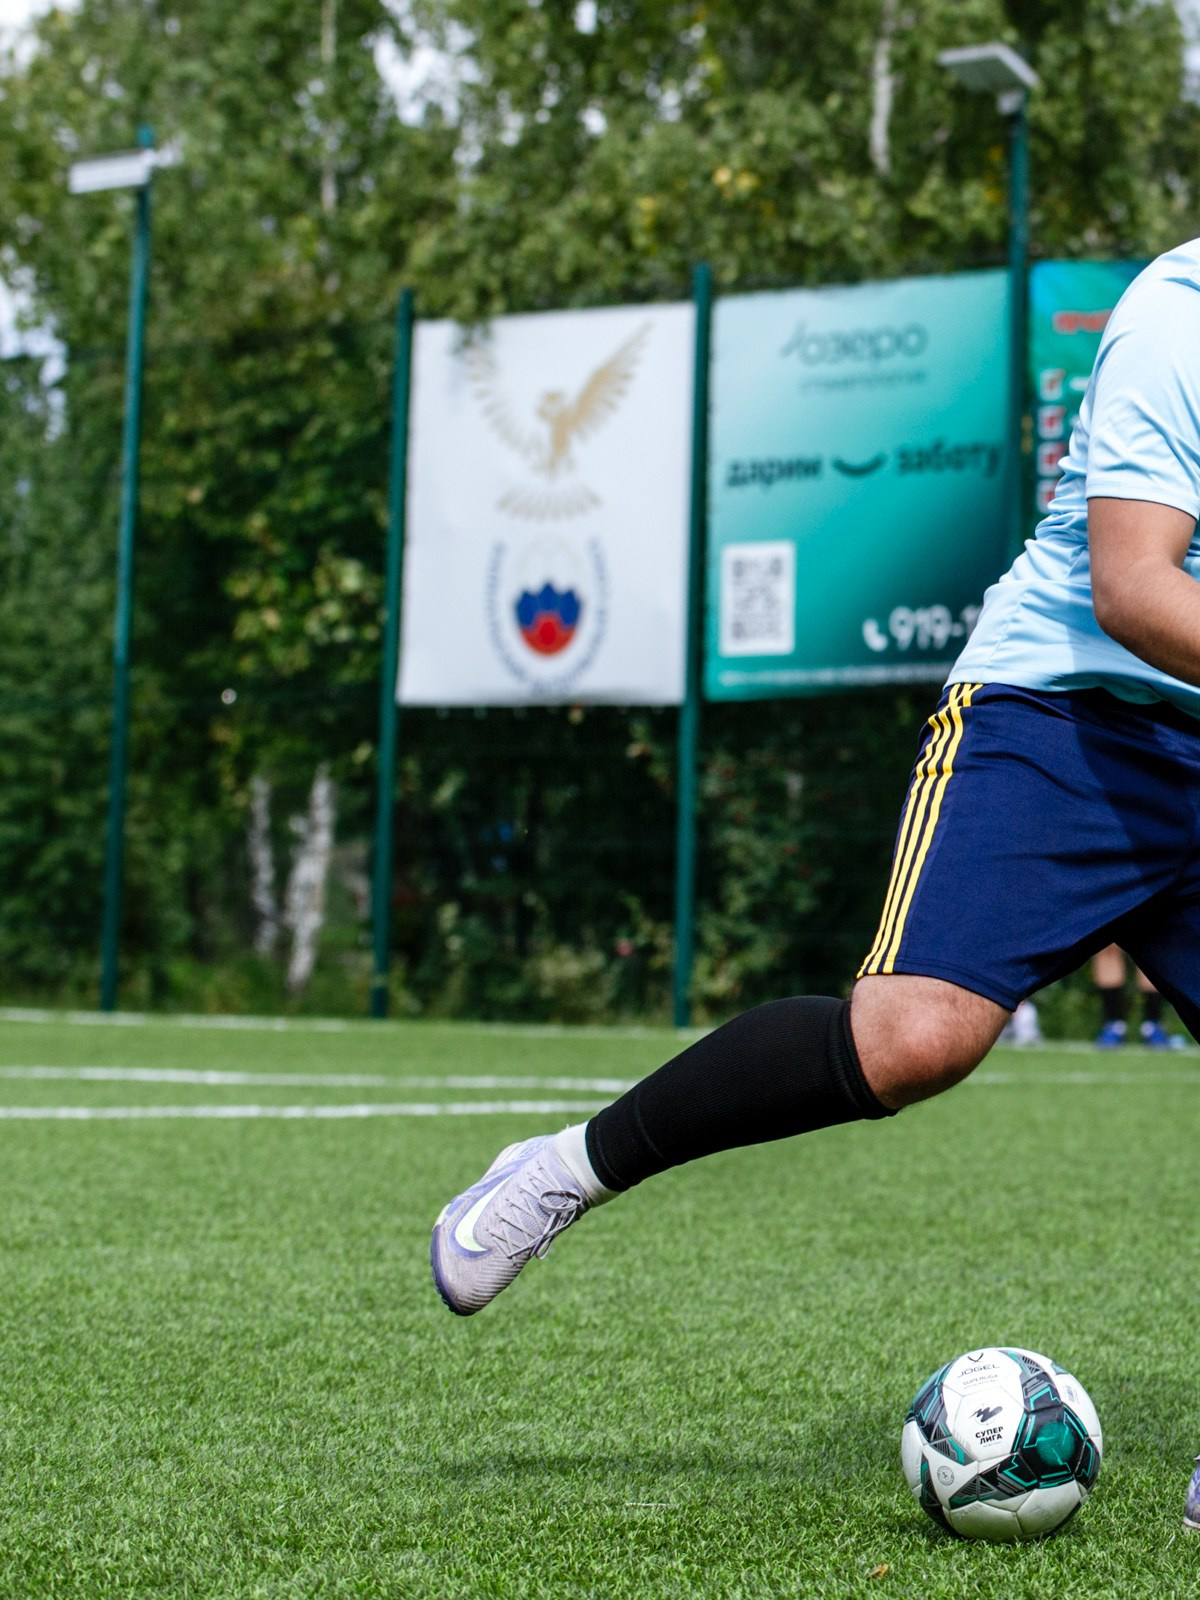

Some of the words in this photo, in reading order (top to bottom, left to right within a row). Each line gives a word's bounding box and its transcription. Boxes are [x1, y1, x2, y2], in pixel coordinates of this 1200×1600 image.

[888, 604, 984, 650] 919-1
[975, 1426, 1004, 1439] СУПЕР
[980, 1433, 1003, 1445] ЛИГА
